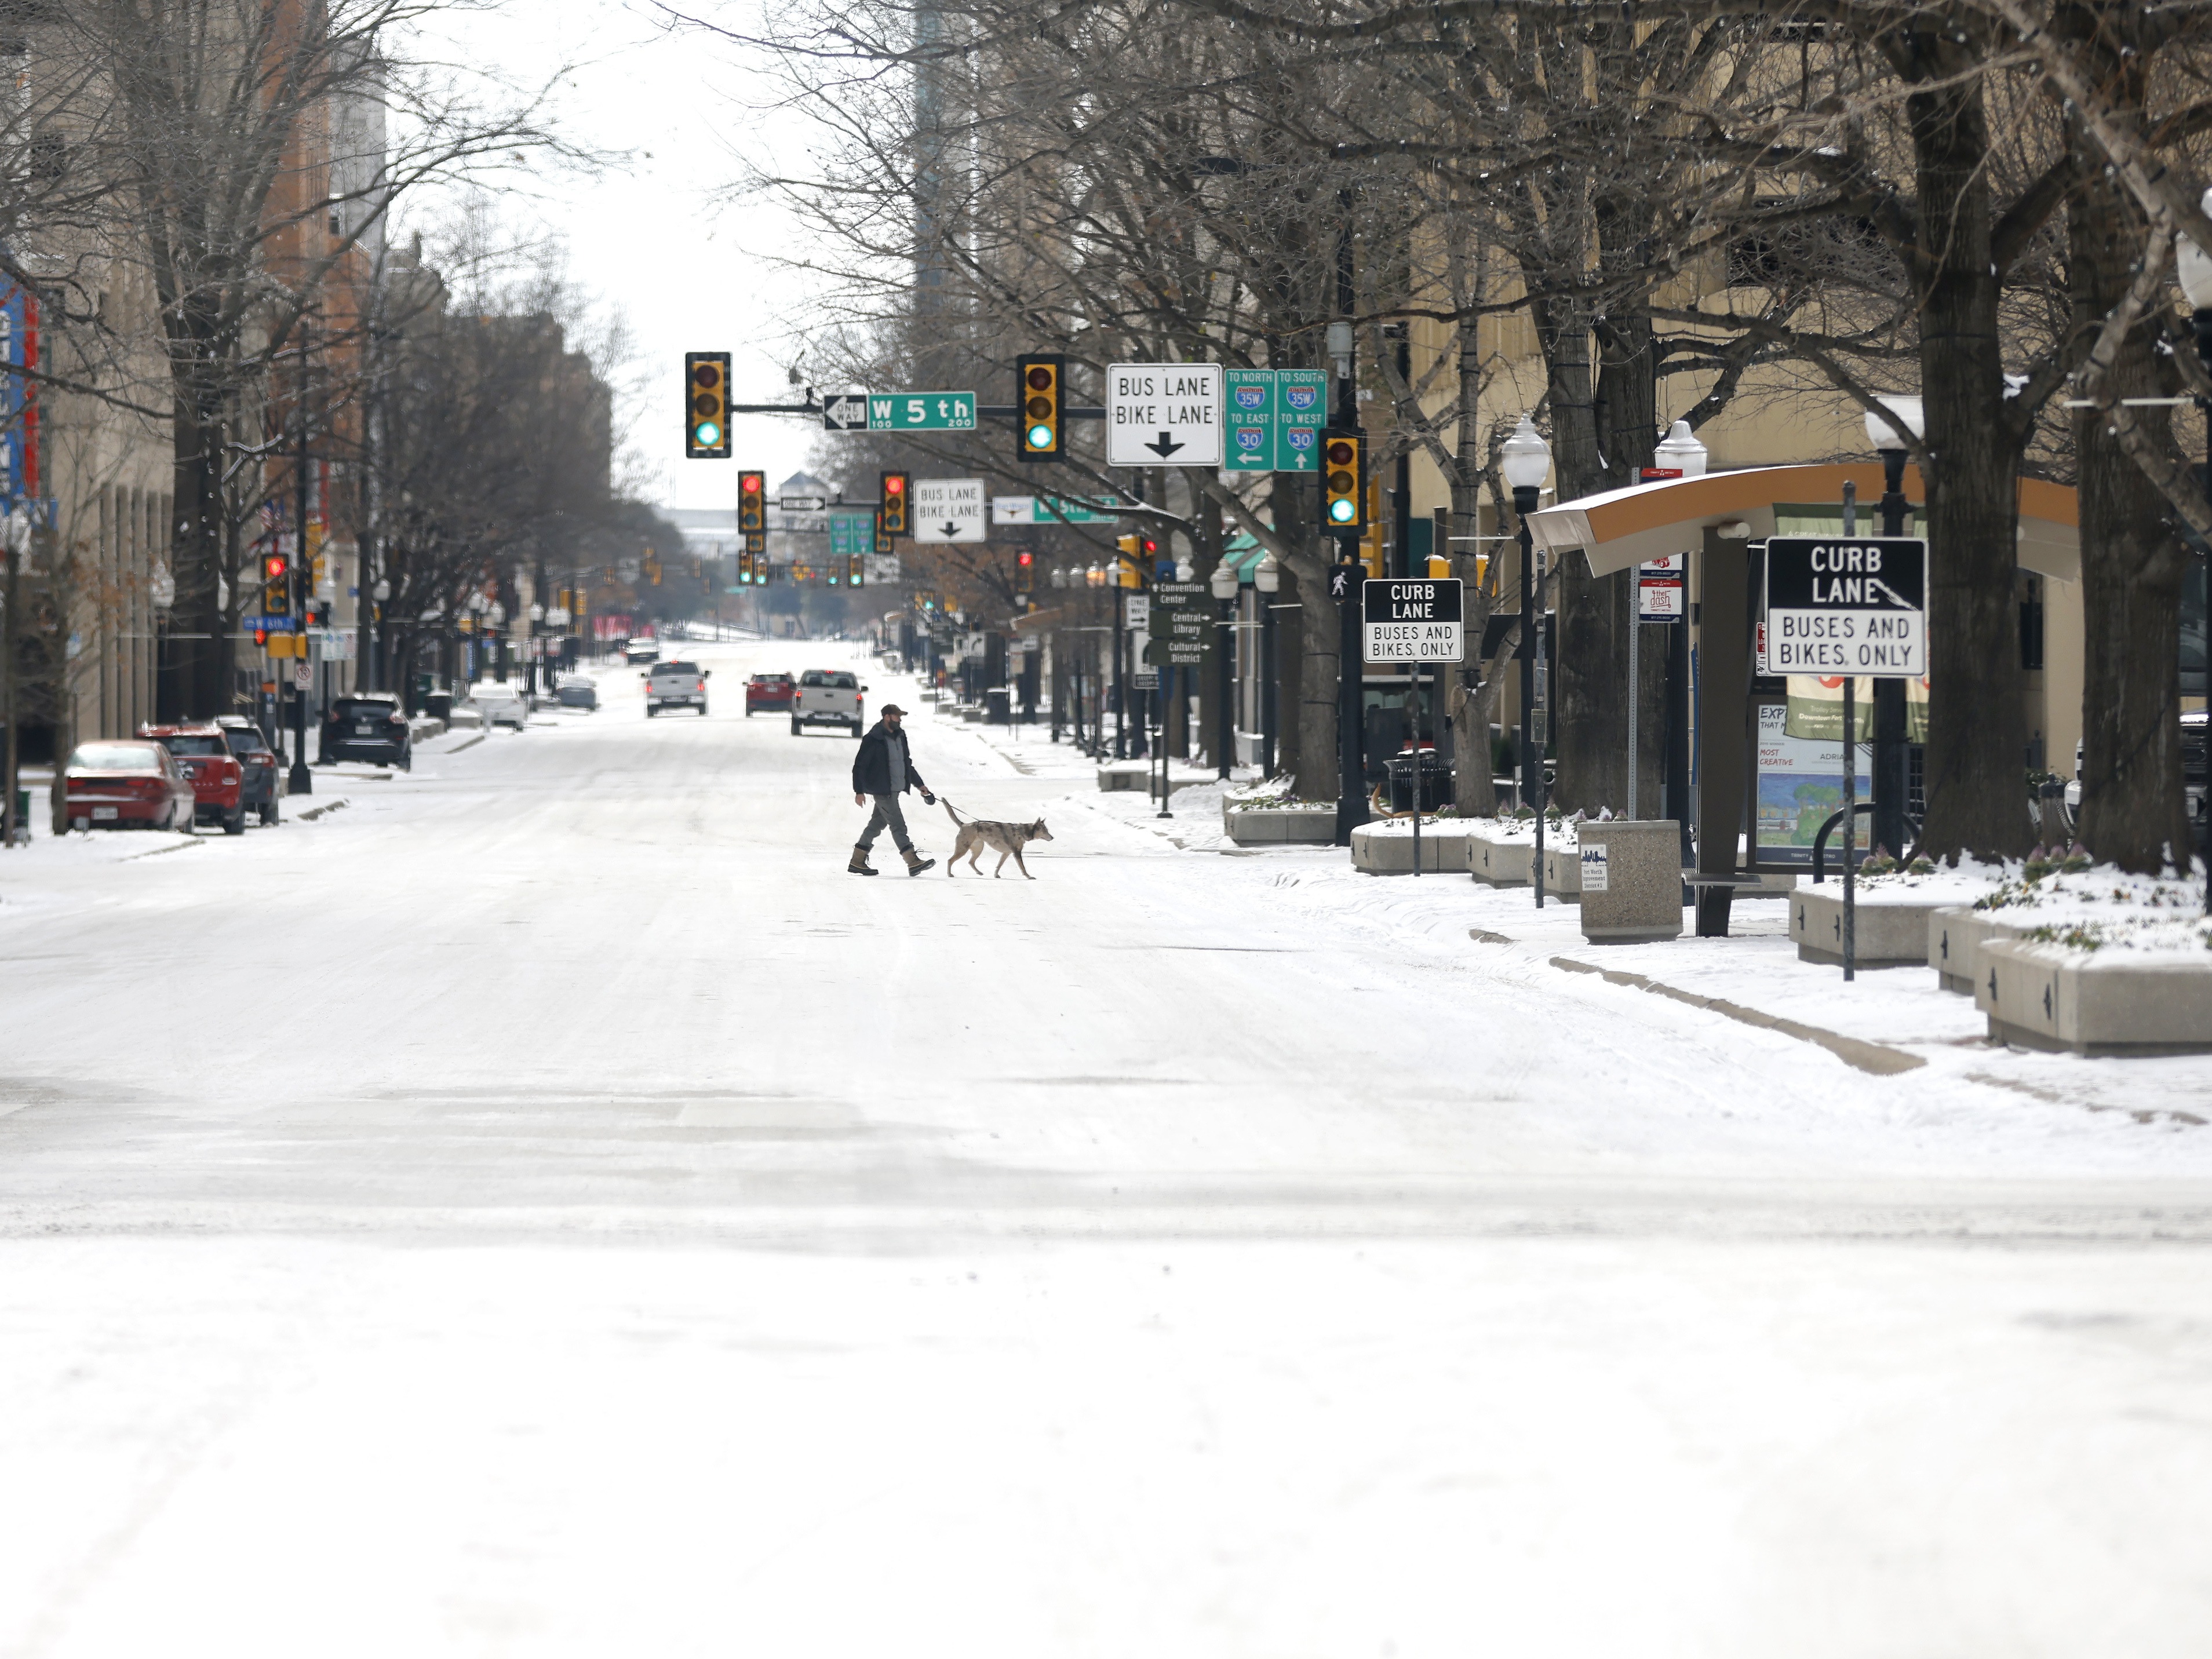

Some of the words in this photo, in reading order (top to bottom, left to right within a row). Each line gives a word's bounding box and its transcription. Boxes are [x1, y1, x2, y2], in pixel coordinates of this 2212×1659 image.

[1229, 373, 1240, 382] TO
[1242, 373, 1272, 382] NORTH
[1280, 373, 1291, 382] TO
[1293, 373, 1324, 382] SOUTH
[1120, 378, 1154, 396] BUS
[1165, 378, 1210, 396] LANE
[1240, 393, 1260, 405] 35W
[1291, 393, 1311, 405] 35W
[837, 404, 859, 412] ONE
[872, 400, 893, 419] W
[837, 412, 859, 420] WAY
[1116, 406, 1157, 424] BIKE
[1168, 406, 1213, 424] LANE
[1231, 413, 1242, 424] TO
[1247, 413, 1269, 424] EAST
[1281, 413, 1292, 424] TO
[1296, 413, 1322, 424] WEST
[872, 420, 892, 428] 100
[948, 418, 972, 427] 200
[1241, 434, 1259, 447] 30
[1292, 433, 1310, 447] 30
[921, 489, 942, 501] BUS
[949, 488, 976, 500] LANE
[920, 505, 944, 518] BIKE
[950, 505, 978, 517] LANE
[1810, 546, 1882, 572] CURB
[1161, 582, 1205, 592] Convention
[1391, 585, 1435, 600] CURB
[1812, 577, 1880, 604] LANE
[1160, 596, 1187, 604] Center
[1650, 590, 1671, 606] dash
[1392, 603, 1434, 618] LANE
[1172, 612, 1201, 622] Central
[1174, 625, 1201, 635] Library
[1375, 627, 1419, 640] BUSES
[1426, 626, 1452, 639] AND
[1783, 616, 1854, 638] BUSES
[1867, 618, 1909, 639] AND
[1169, 643, 1201, 652] Cultural
[1373, 643, 1412, 656] BIKES
[1421, 643, 1454, 656] ONLY
[1171, 654, 1201, 663] District
[1780, 643, 1845, 665] BIKES
[1859, 644, 1912, 666] ONLY
[1761, 708, 1785, 719] EXP
[1798, 713, 1831, 721] Downtown
